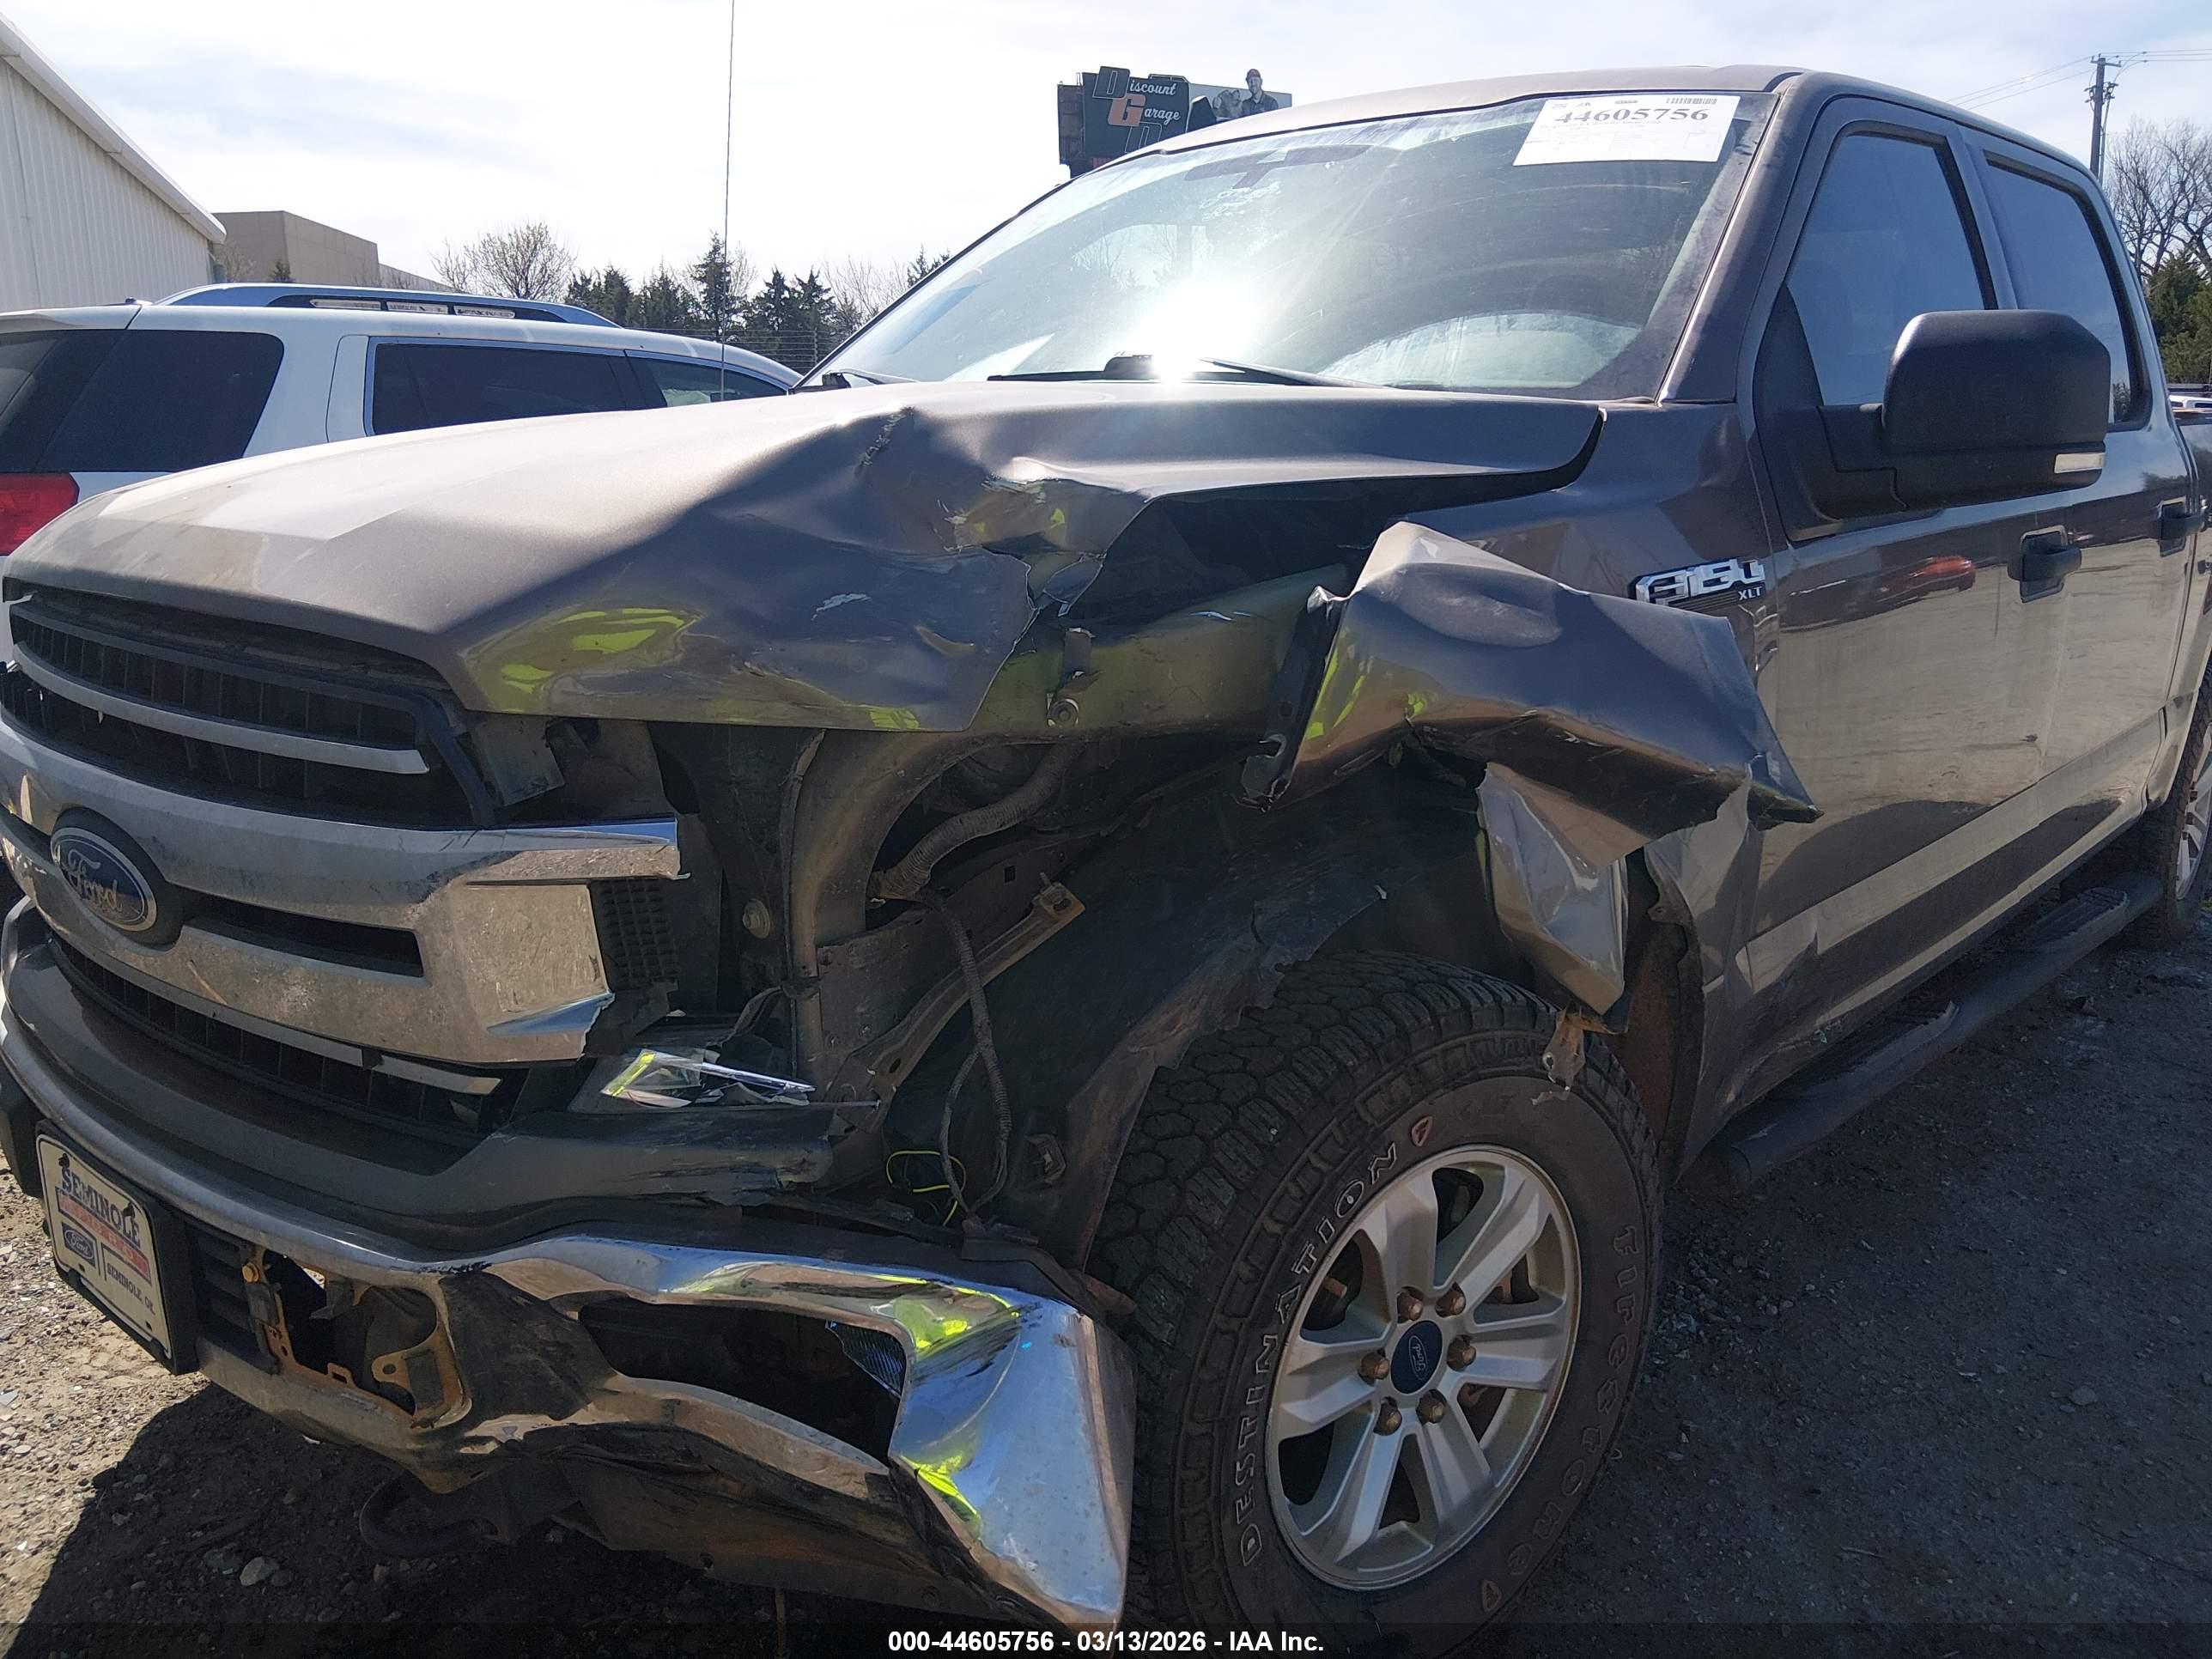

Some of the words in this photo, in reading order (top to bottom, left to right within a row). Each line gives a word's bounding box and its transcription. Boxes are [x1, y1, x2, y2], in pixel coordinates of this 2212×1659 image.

[1092, 65, 1177, 100] Discount
[1108, 93, 1182, 127] Garage
[1555, 108, 1709, 124] 44605756
[1738, 586, 1763, 600] XLT
[62, 848, 123, 912] Ford
[61, 1165, 142, 1249] SEMINOLE
[1234, 1142, 1398, 1567] DESTINATION
